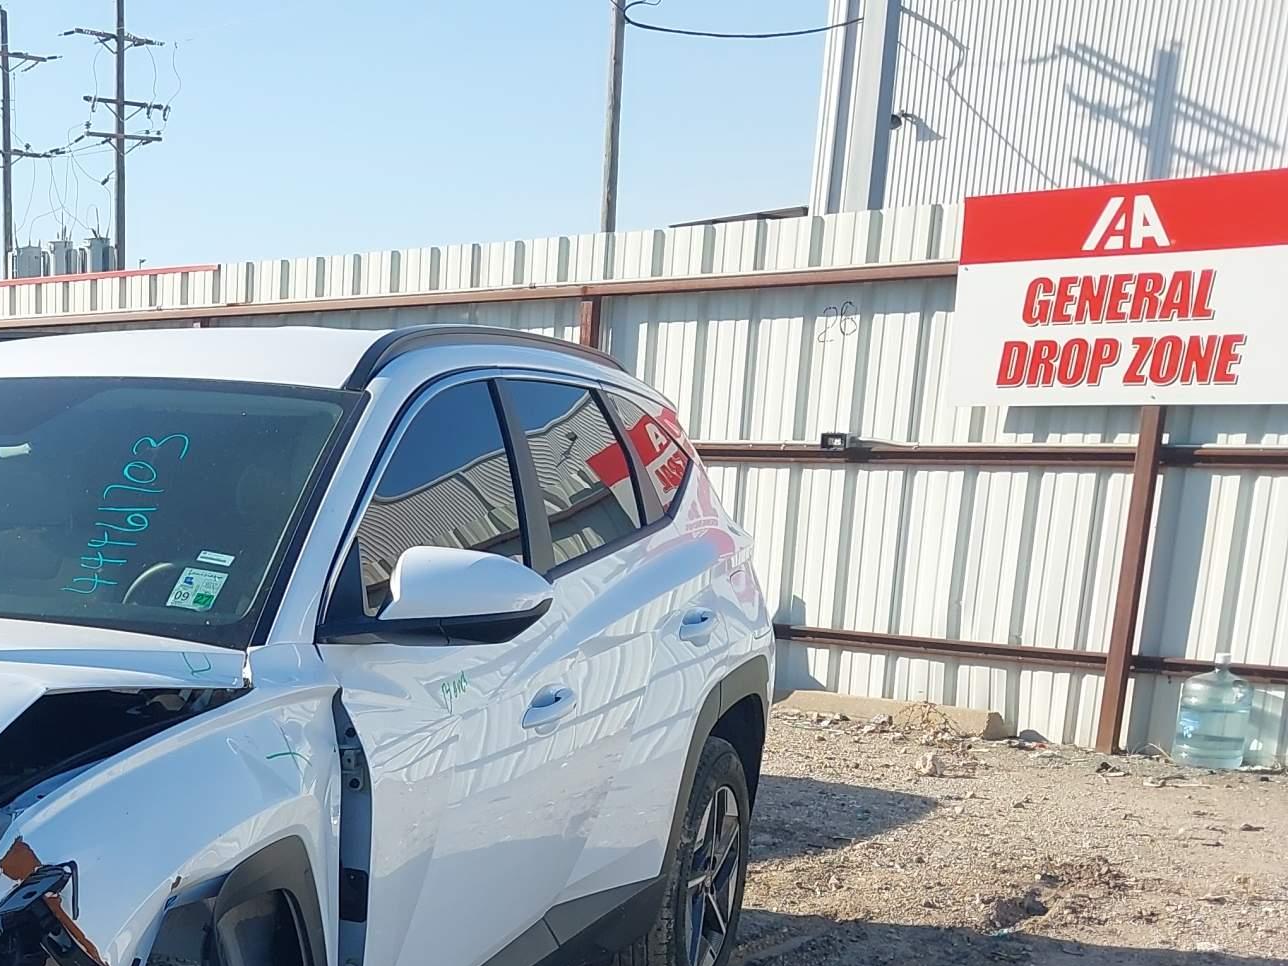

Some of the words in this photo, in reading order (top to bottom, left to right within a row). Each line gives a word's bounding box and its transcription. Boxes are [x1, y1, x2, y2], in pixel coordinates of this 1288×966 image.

[1081, 195, 1171, 251] IAA
[1022, 268, 1217, 327] GENERAL
[995, 337, 1123, 388] DROP
[1122, 333, 1247, 387] ZONE
[60, 433, 190, 594] 44461703
[174, 590, 190, 601] 09
[193, 594, 215, 606] 27
